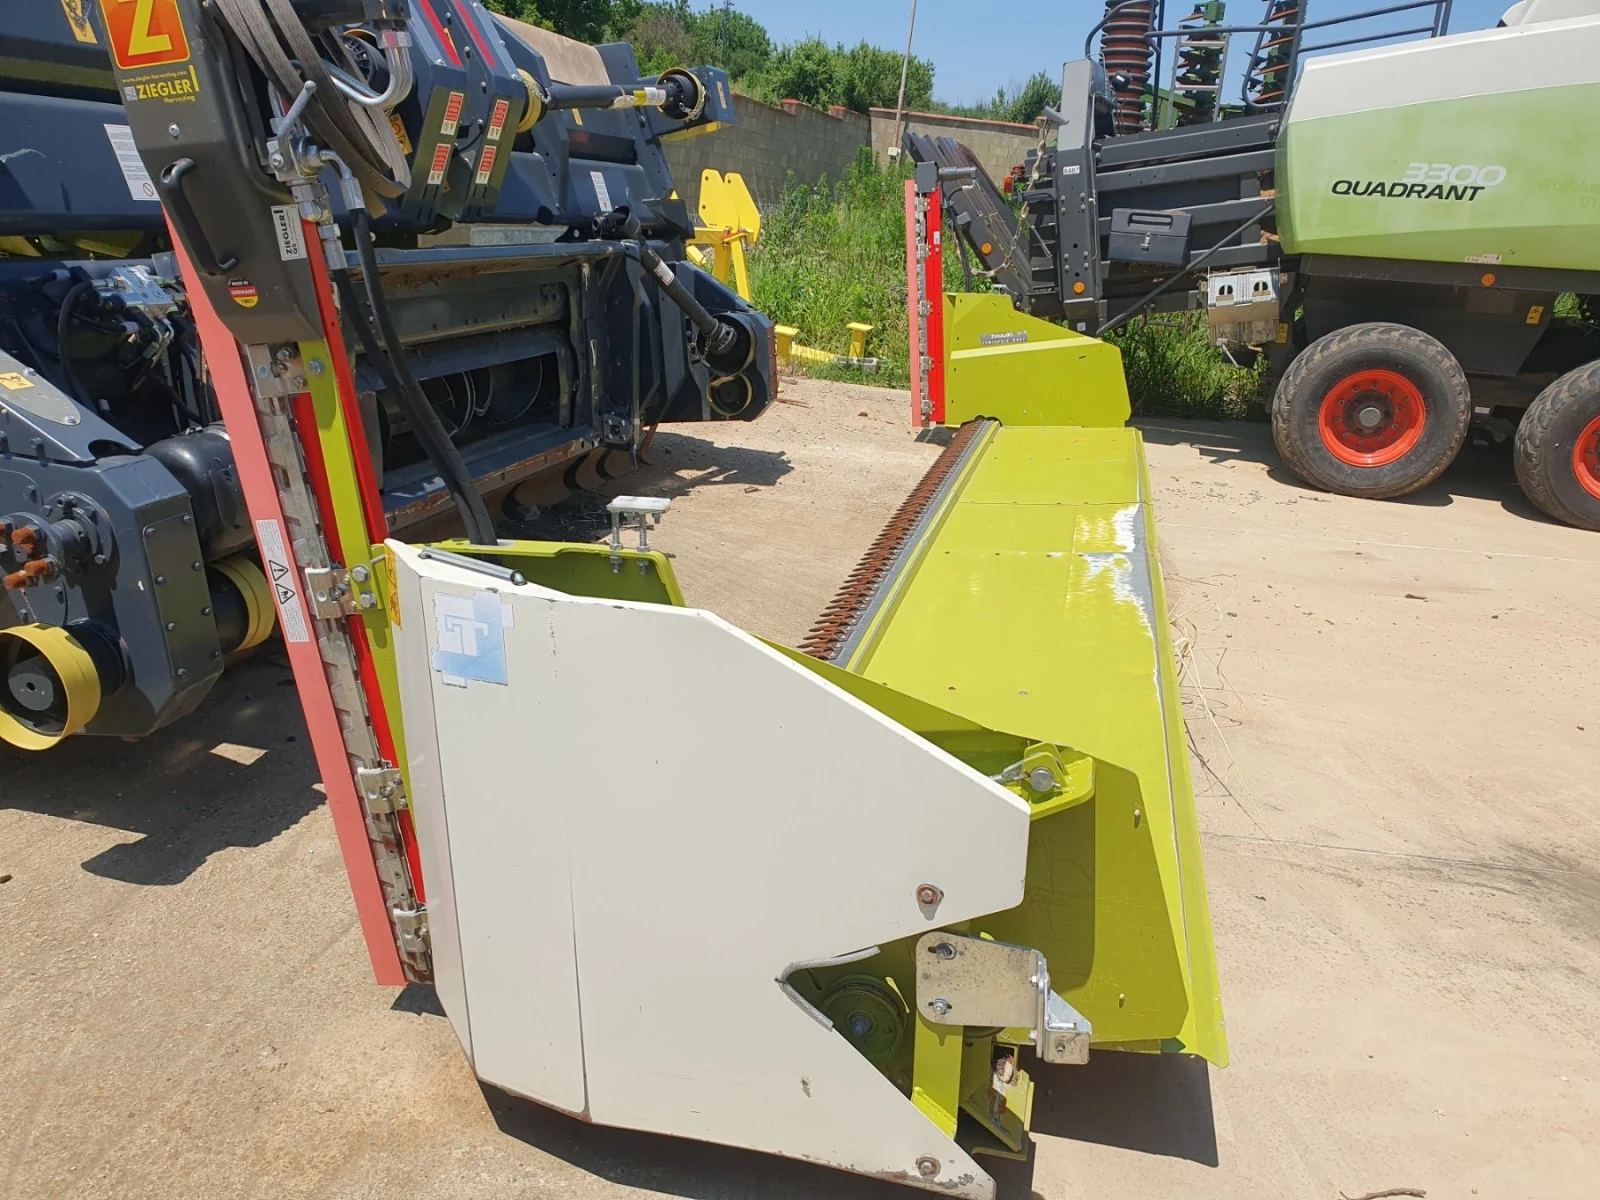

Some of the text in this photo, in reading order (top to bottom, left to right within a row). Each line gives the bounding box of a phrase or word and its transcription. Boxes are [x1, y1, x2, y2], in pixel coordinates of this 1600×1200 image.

[116, 0, 172, 57] Z
[136, 79, 192, 99] ZIEGLER
[164, 94, 195, 104] Harvesting
[1401, 161, 1507, 186] 3300
[1331, 179, 1485, 202] QUADRANT
[278, 214, 293, 255] ZIEGLER
